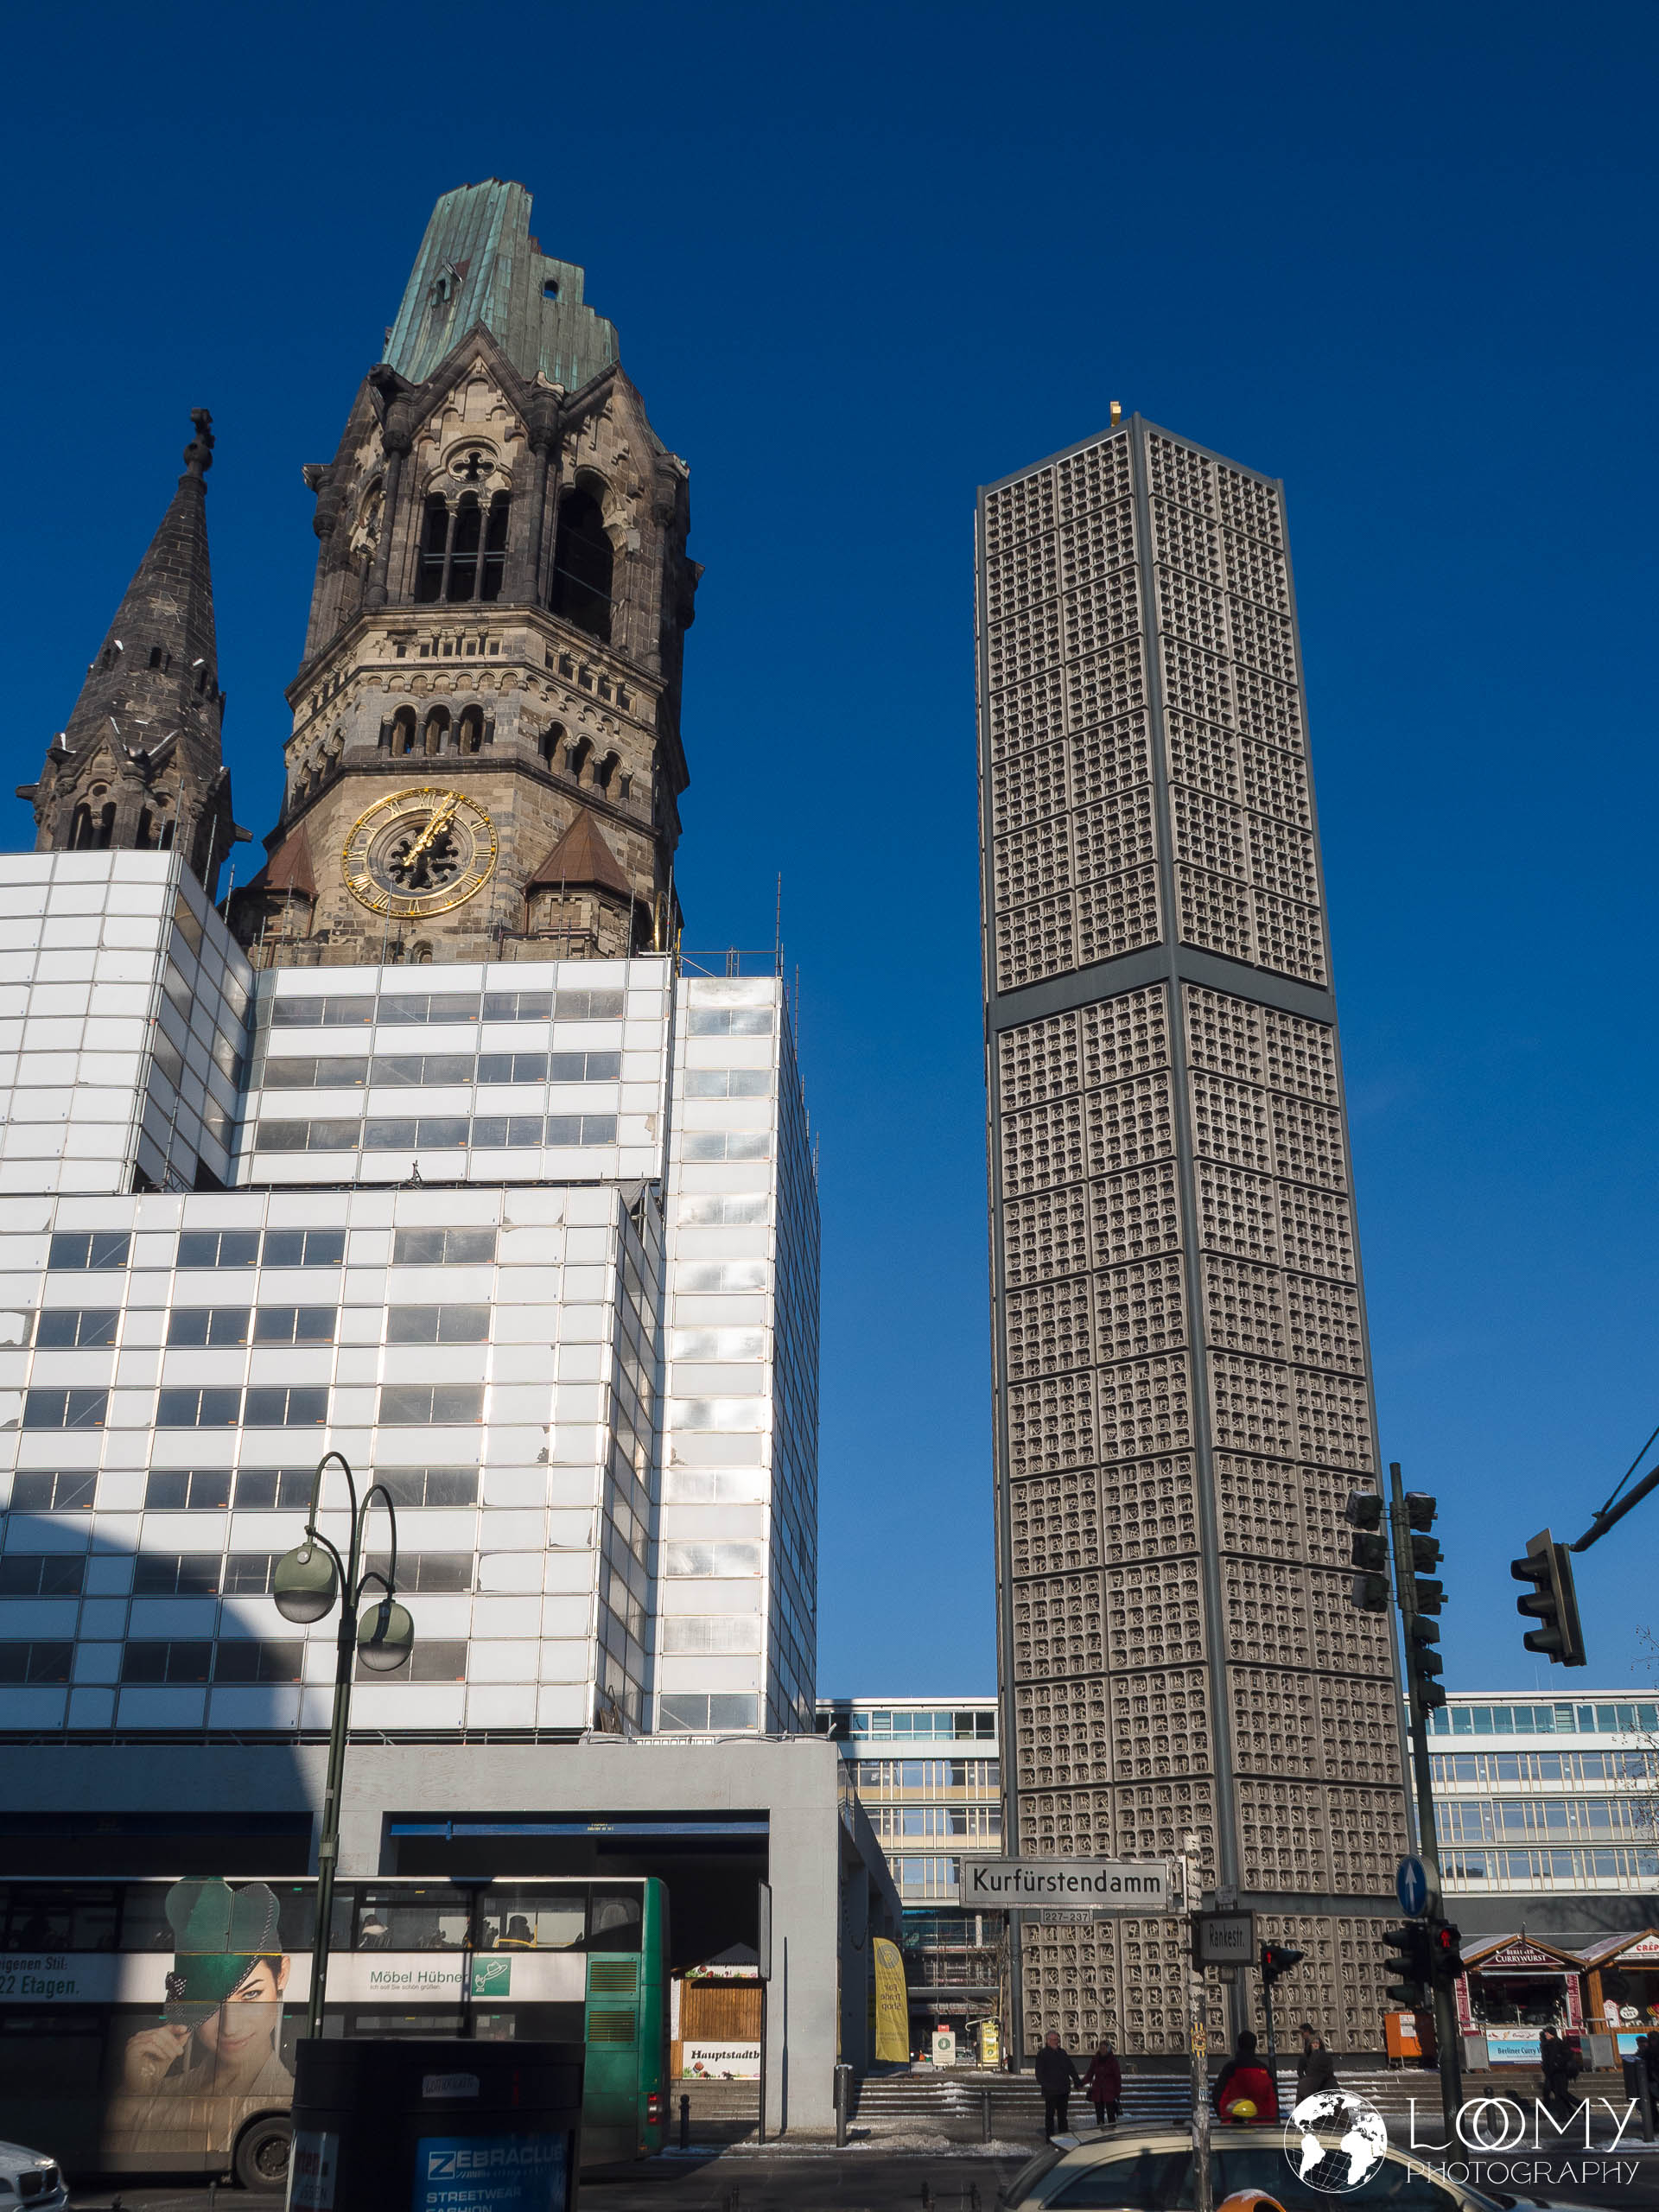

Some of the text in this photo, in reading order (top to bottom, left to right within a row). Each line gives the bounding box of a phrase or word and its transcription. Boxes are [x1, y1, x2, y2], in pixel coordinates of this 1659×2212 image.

[974, 1868, 1160, 1892] Kurfürstendamm
[1046, 1912, 1089, 1922] 227-237
[1209, 1923, 1245, 1948] Rankestr.
[1495, 1955, 1548, 1963] CURRYWURST
[371, 1970, 468, 1984] Möbel Hübner
[21, 1975, 80, 1999] Etagen.
[1521, 2046, 1536, 2055] Curry
[426, 2186, 523, 2204] STREETWEAR
